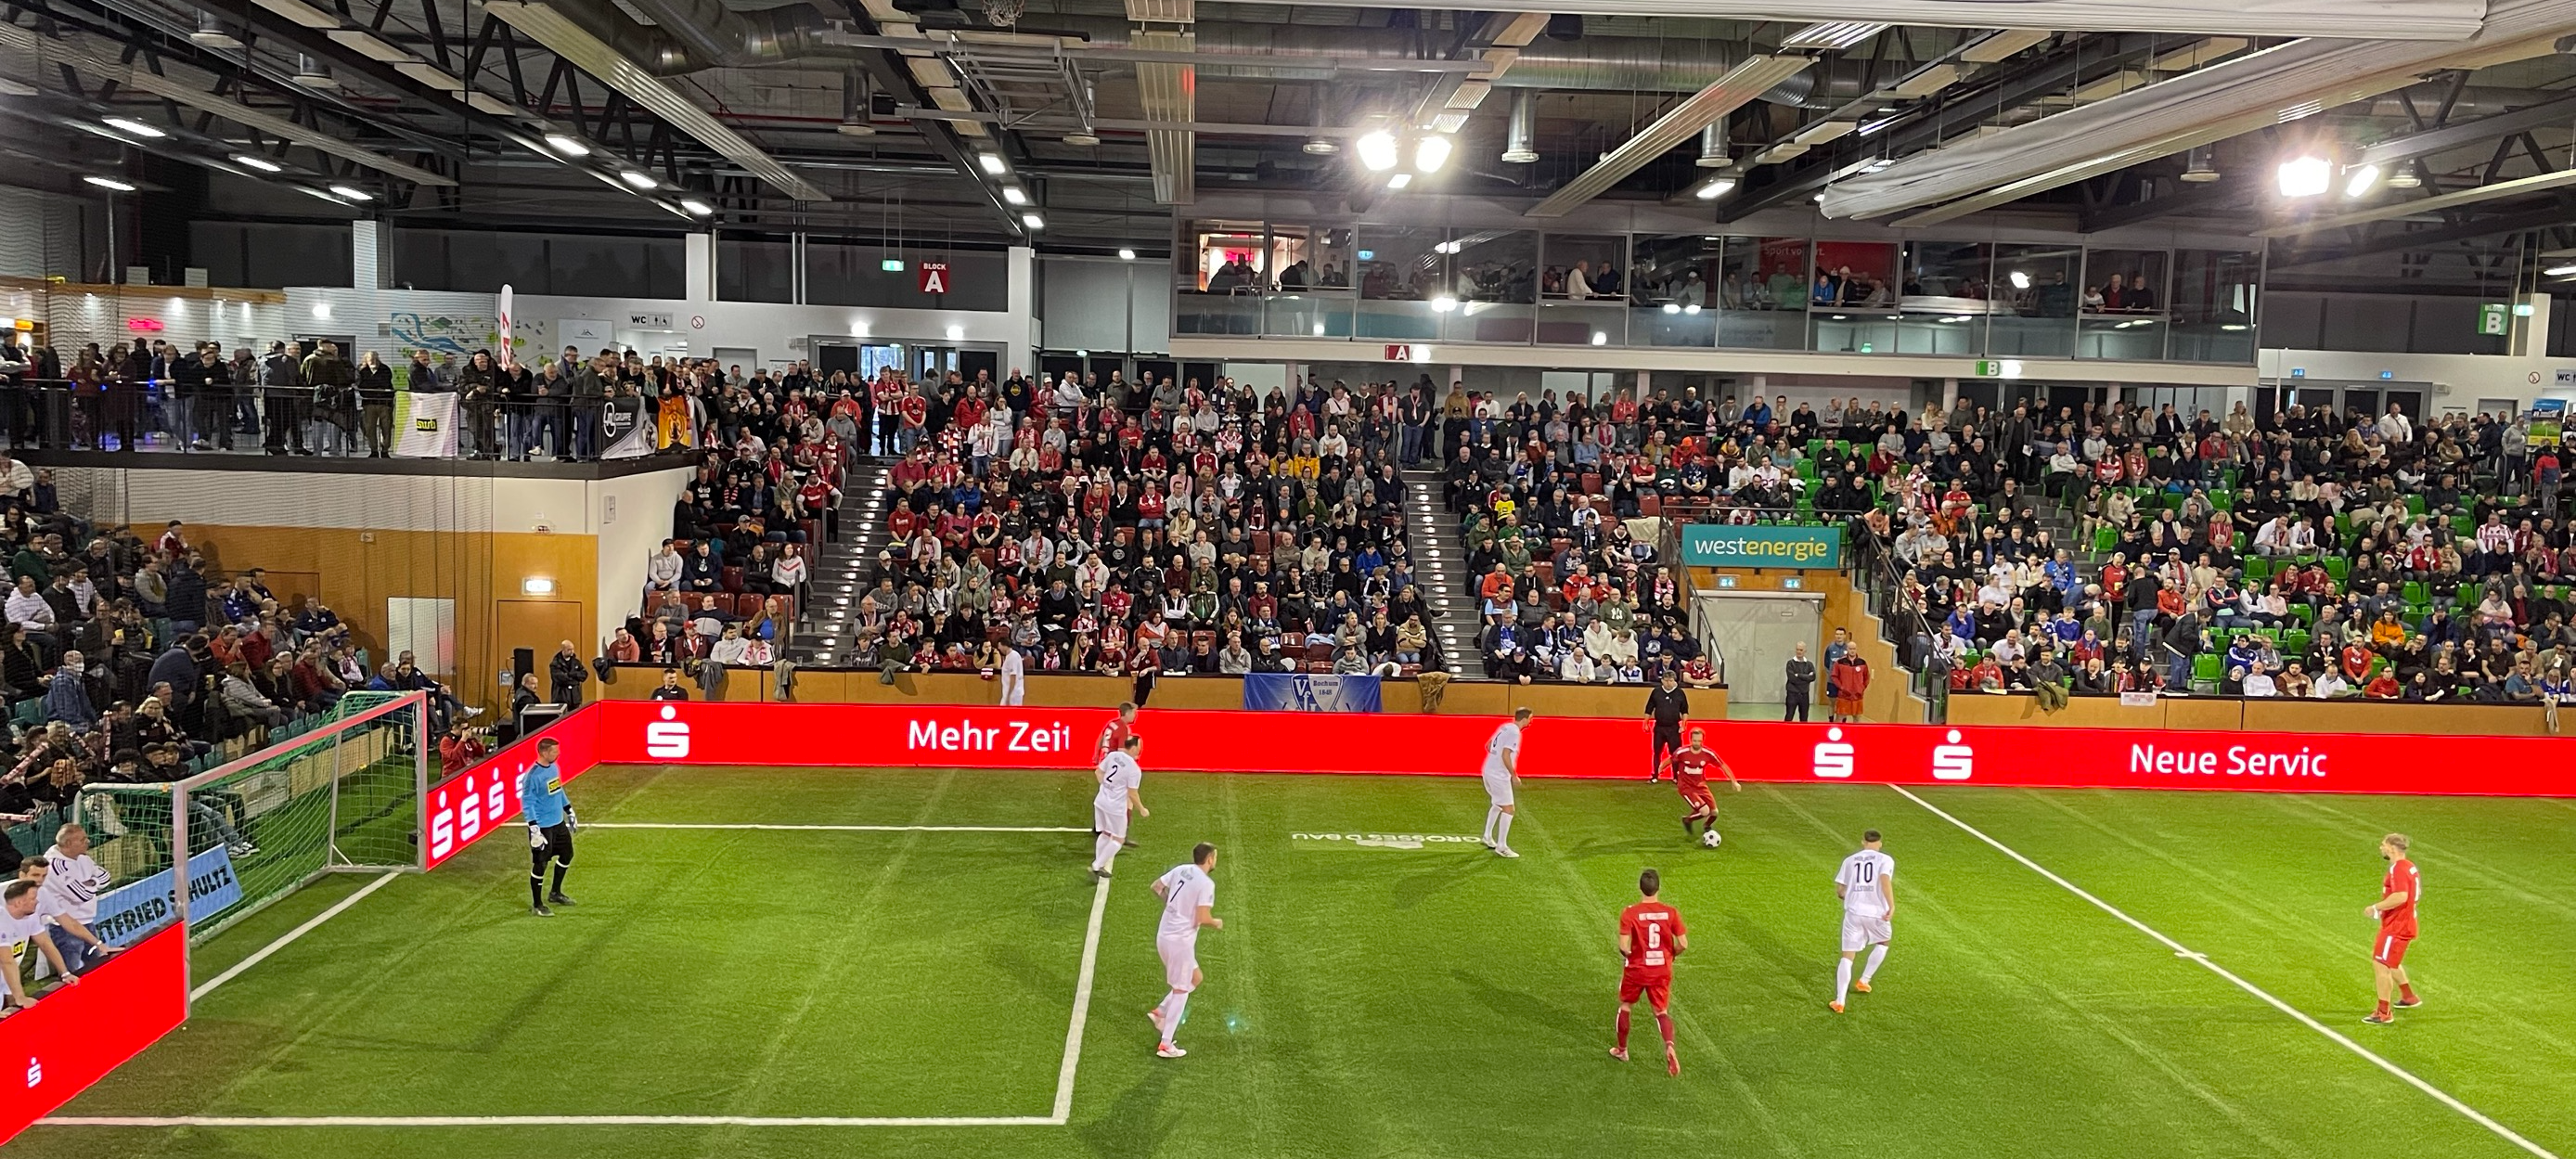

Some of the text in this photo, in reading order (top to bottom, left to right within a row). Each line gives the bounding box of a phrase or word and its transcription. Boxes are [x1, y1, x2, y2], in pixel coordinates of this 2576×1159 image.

[924, 270, 944, 293] A
[631, 316, 647, 324] WC
[2485, 312, 2502, 333] B
[1395, 345, 1409, 360] A
[1988, 361, 1999, 376] B
[2557, 373, 2570, 381] WC
[1694, 536, 1827, 561] westenergie
[908, 719, 1000, 751] Mehr
[2131, 743, 2327, 777] Neue Servic
[1106, 765, 1118, 783] 2
[1854, 862, 1874, 883] 10
[168, 865, 232, 912] SHULTZ
[1170, 880, 1185, 903] 7
[1649, 922, 1661, 949] 6
